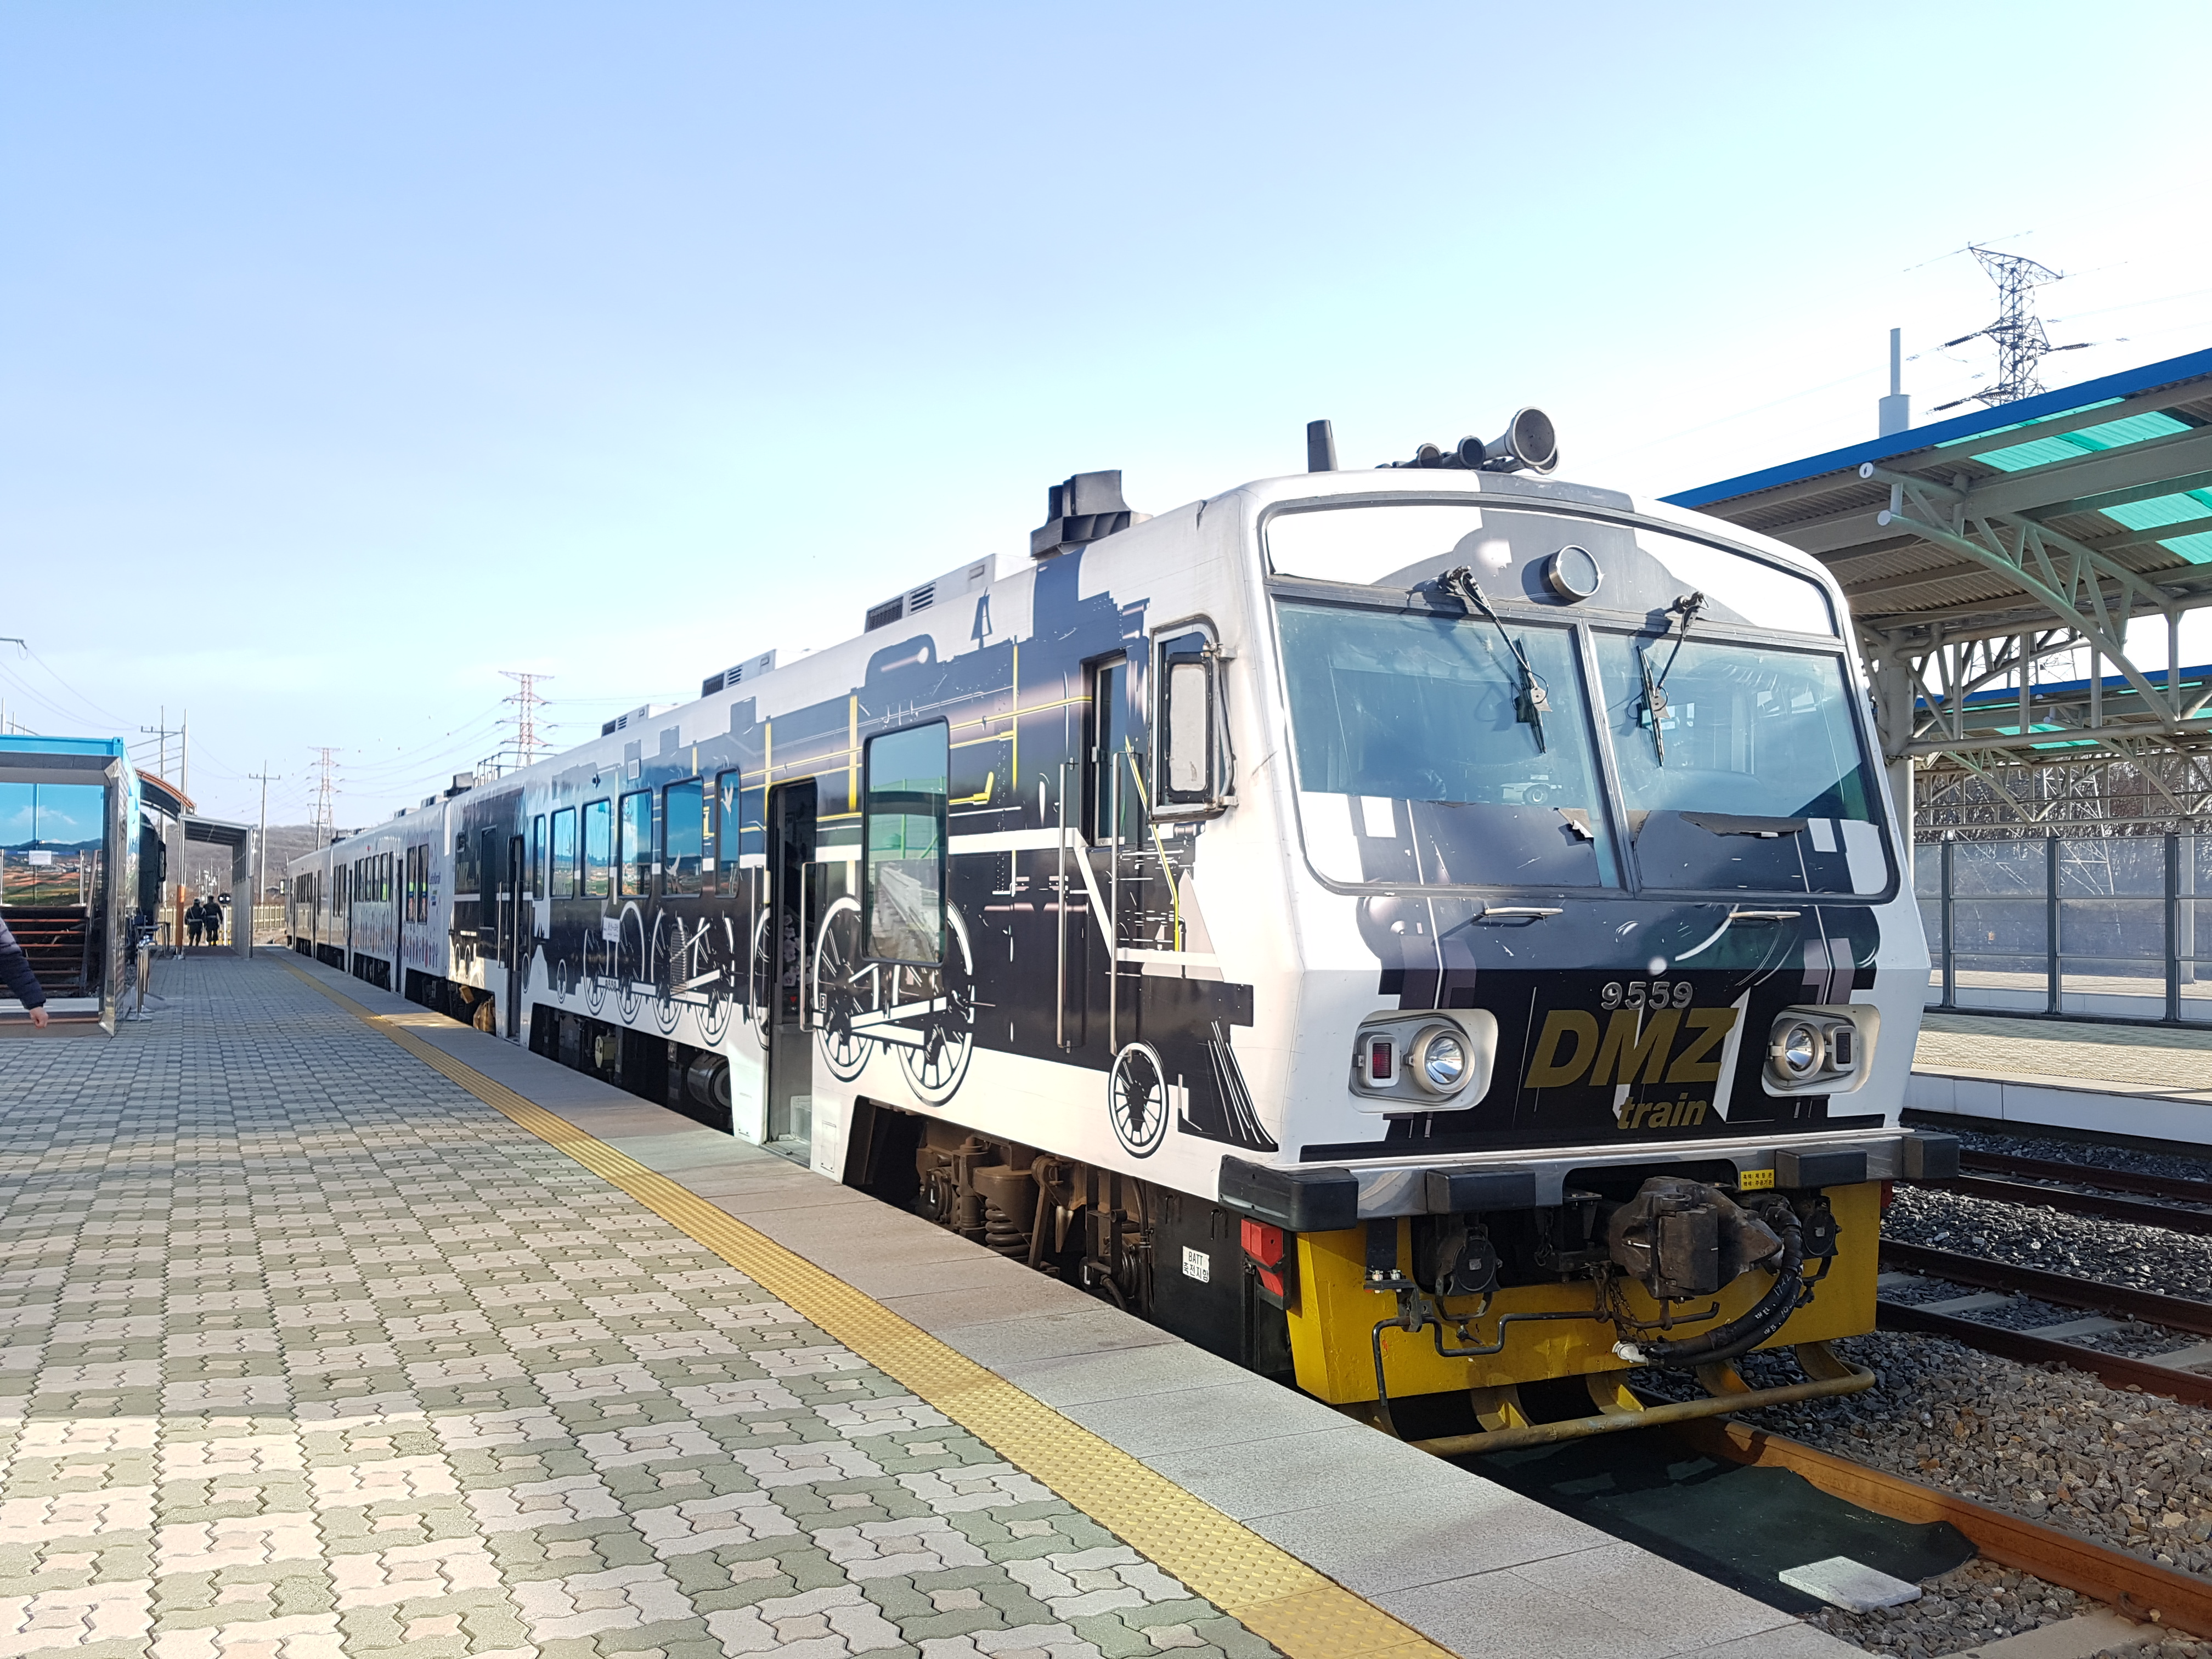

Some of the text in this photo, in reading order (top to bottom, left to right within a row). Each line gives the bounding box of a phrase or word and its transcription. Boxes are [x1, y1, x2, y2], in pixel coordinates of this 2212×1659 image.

[1601, 981, 1693, 1010] 9559
[1524, 1007, 1740, 1088] DMZ
[1617, 1092, 1707, 1130] train
[1188, 1251, 1203, 1266] BATT
